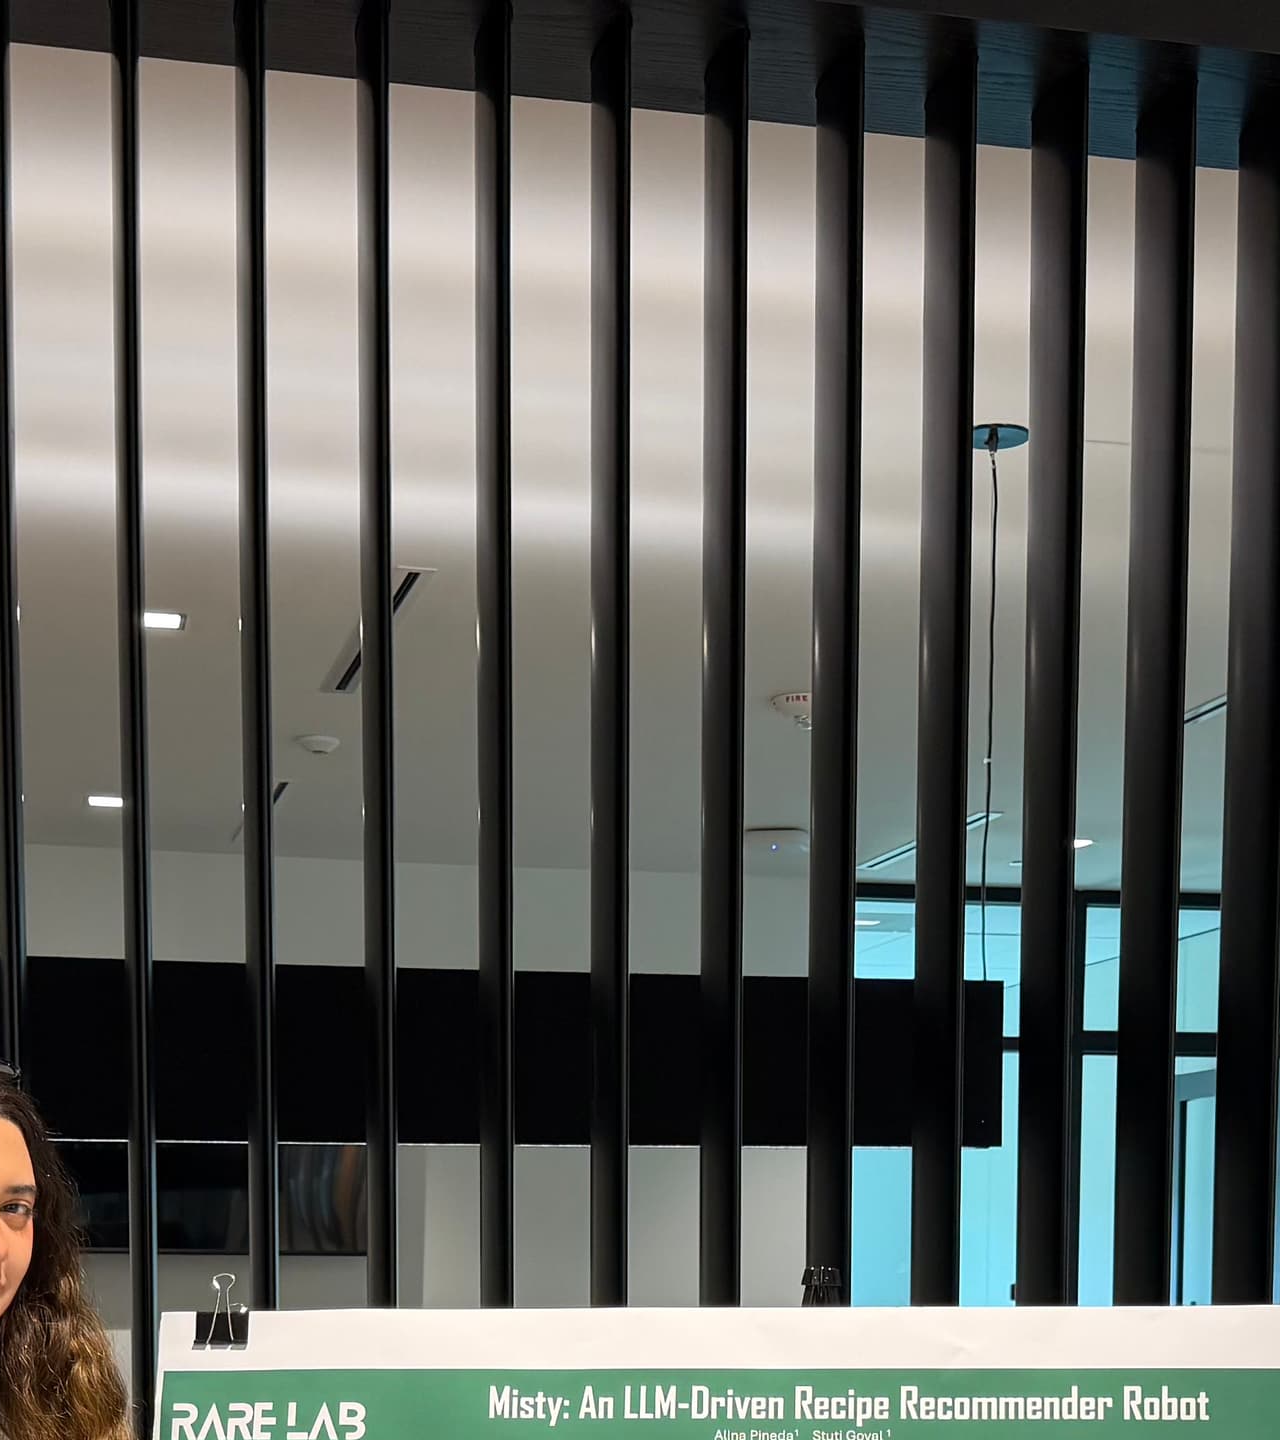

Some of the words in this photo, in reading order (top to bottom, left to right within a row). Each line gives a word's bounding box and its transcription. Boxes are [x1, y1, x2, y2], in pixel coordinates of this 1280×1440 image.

[785, 695, 808, 703] FIRE
[488, 1384, 570, 1426] Misty:
[578, 1385, 614, 1419] An
[623, 1384, 784, 1419] LLM-Driven
[794, 1385, 889, 1427] Recipe
[900, 1385, 1113, 1420] Recommender
[1123, 1385, 1209, 1420] Robot
[171, 1402, 277, 1440] RARE
[287, 1402, 366, 1440] LAB
[713, 1428, 746, 1440] Alina
[812, 1429, 842, 1440] Stuti
